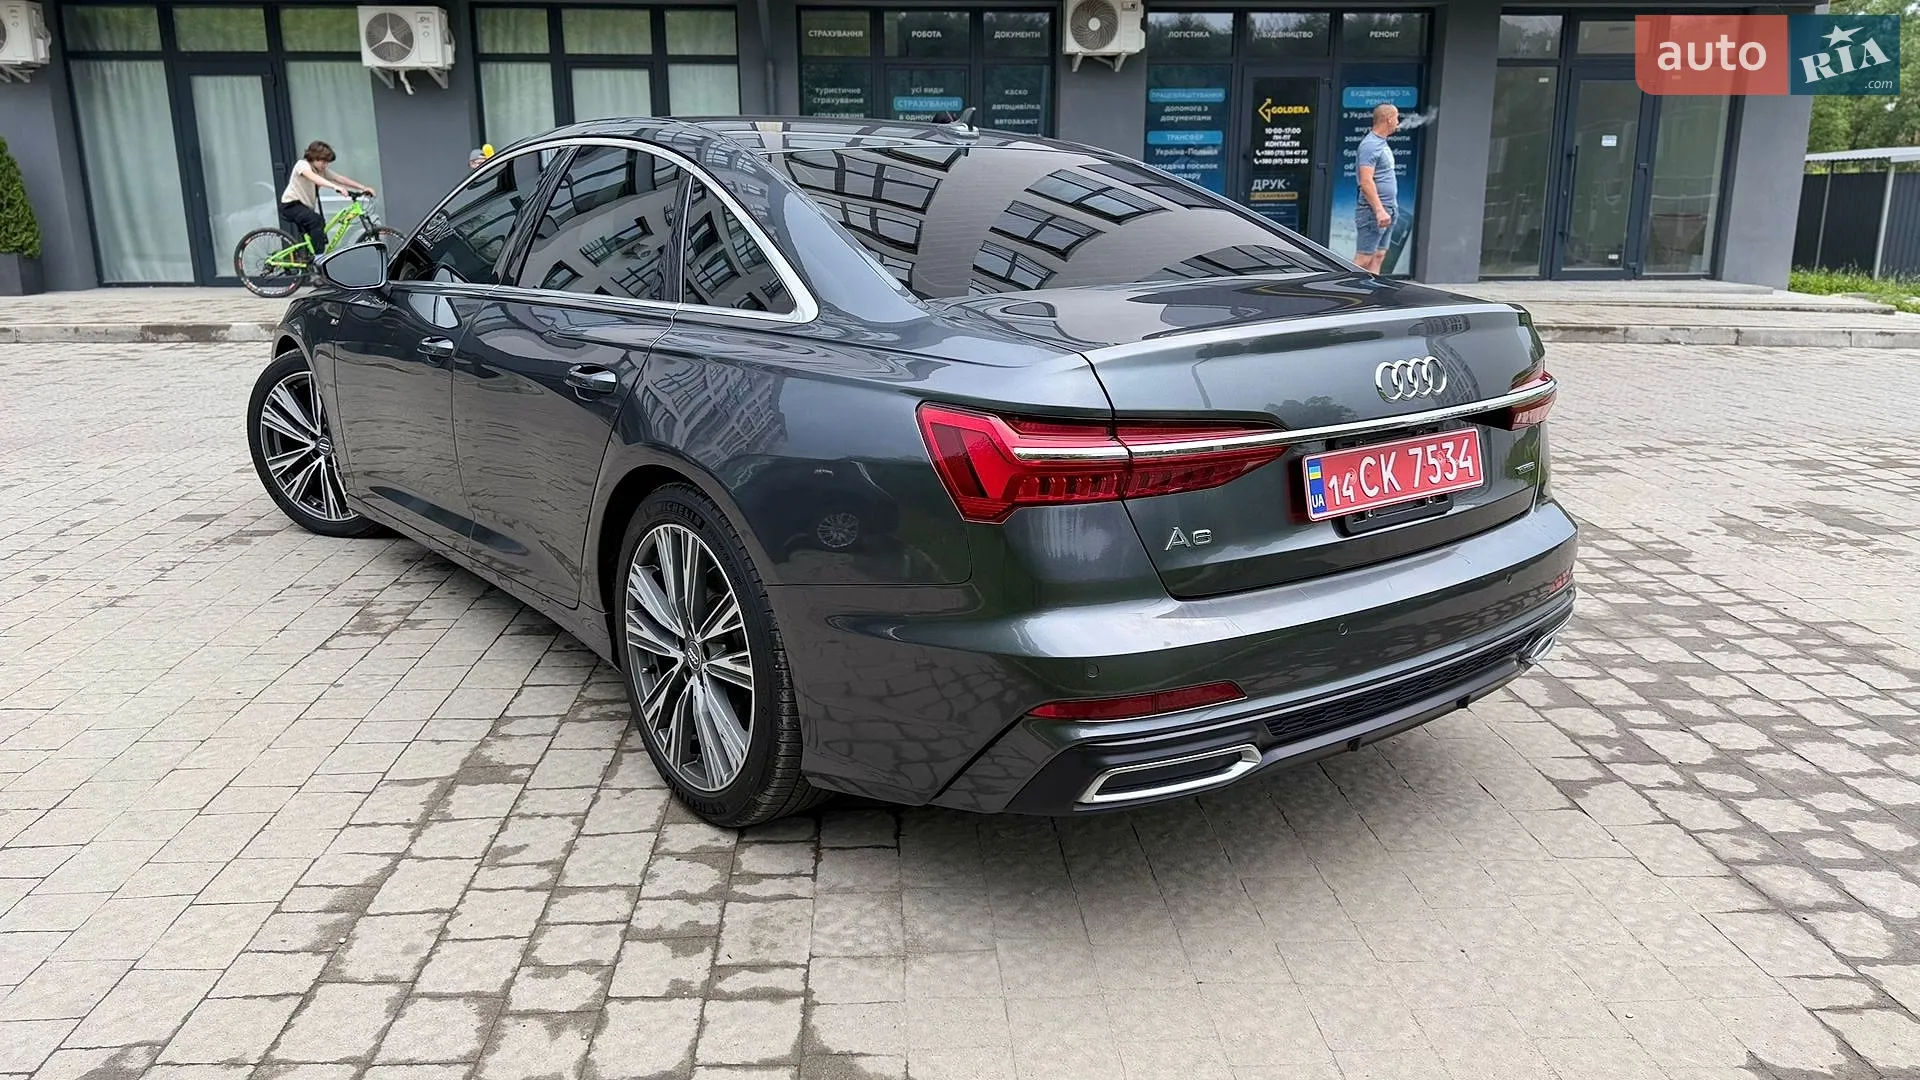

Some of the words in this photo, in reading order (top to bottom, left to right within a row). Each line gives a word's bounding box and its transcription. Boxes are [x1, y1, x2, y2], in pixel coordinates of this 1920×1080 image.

[808, 30, 863, 38] СТРАХУВАННЯ
[911, 30, 942, 38] РОБОТА
[994, 30, 1041, 39] ДОКУМЕНТИ
[1168, 30, 1210, 39] ЛОГІСТИКА
[1262, 31, 1313, 39] БУДІВНИЦТВО
[1369, 30, 1400, 38] РЕМОНТ
[815, 87, 861, 96] туристичне
[911, 86, 922, 95] усі
[1005, 88, 1028, 96] каско
[813, 97, 864, 106] страхування
[896, 100, 959, 108] СТРАХУВАННЯ
[992, 102, 1041, 111] автоцивілка
[1271, 106, 1310, 114] GOLDERA
[994, 118, 1038, 126] автозахист
[1408, 438, 1474, 488] 7534
[1311, 494, 1325, 508] UA
[1164, 526, 1213, 551] A6
